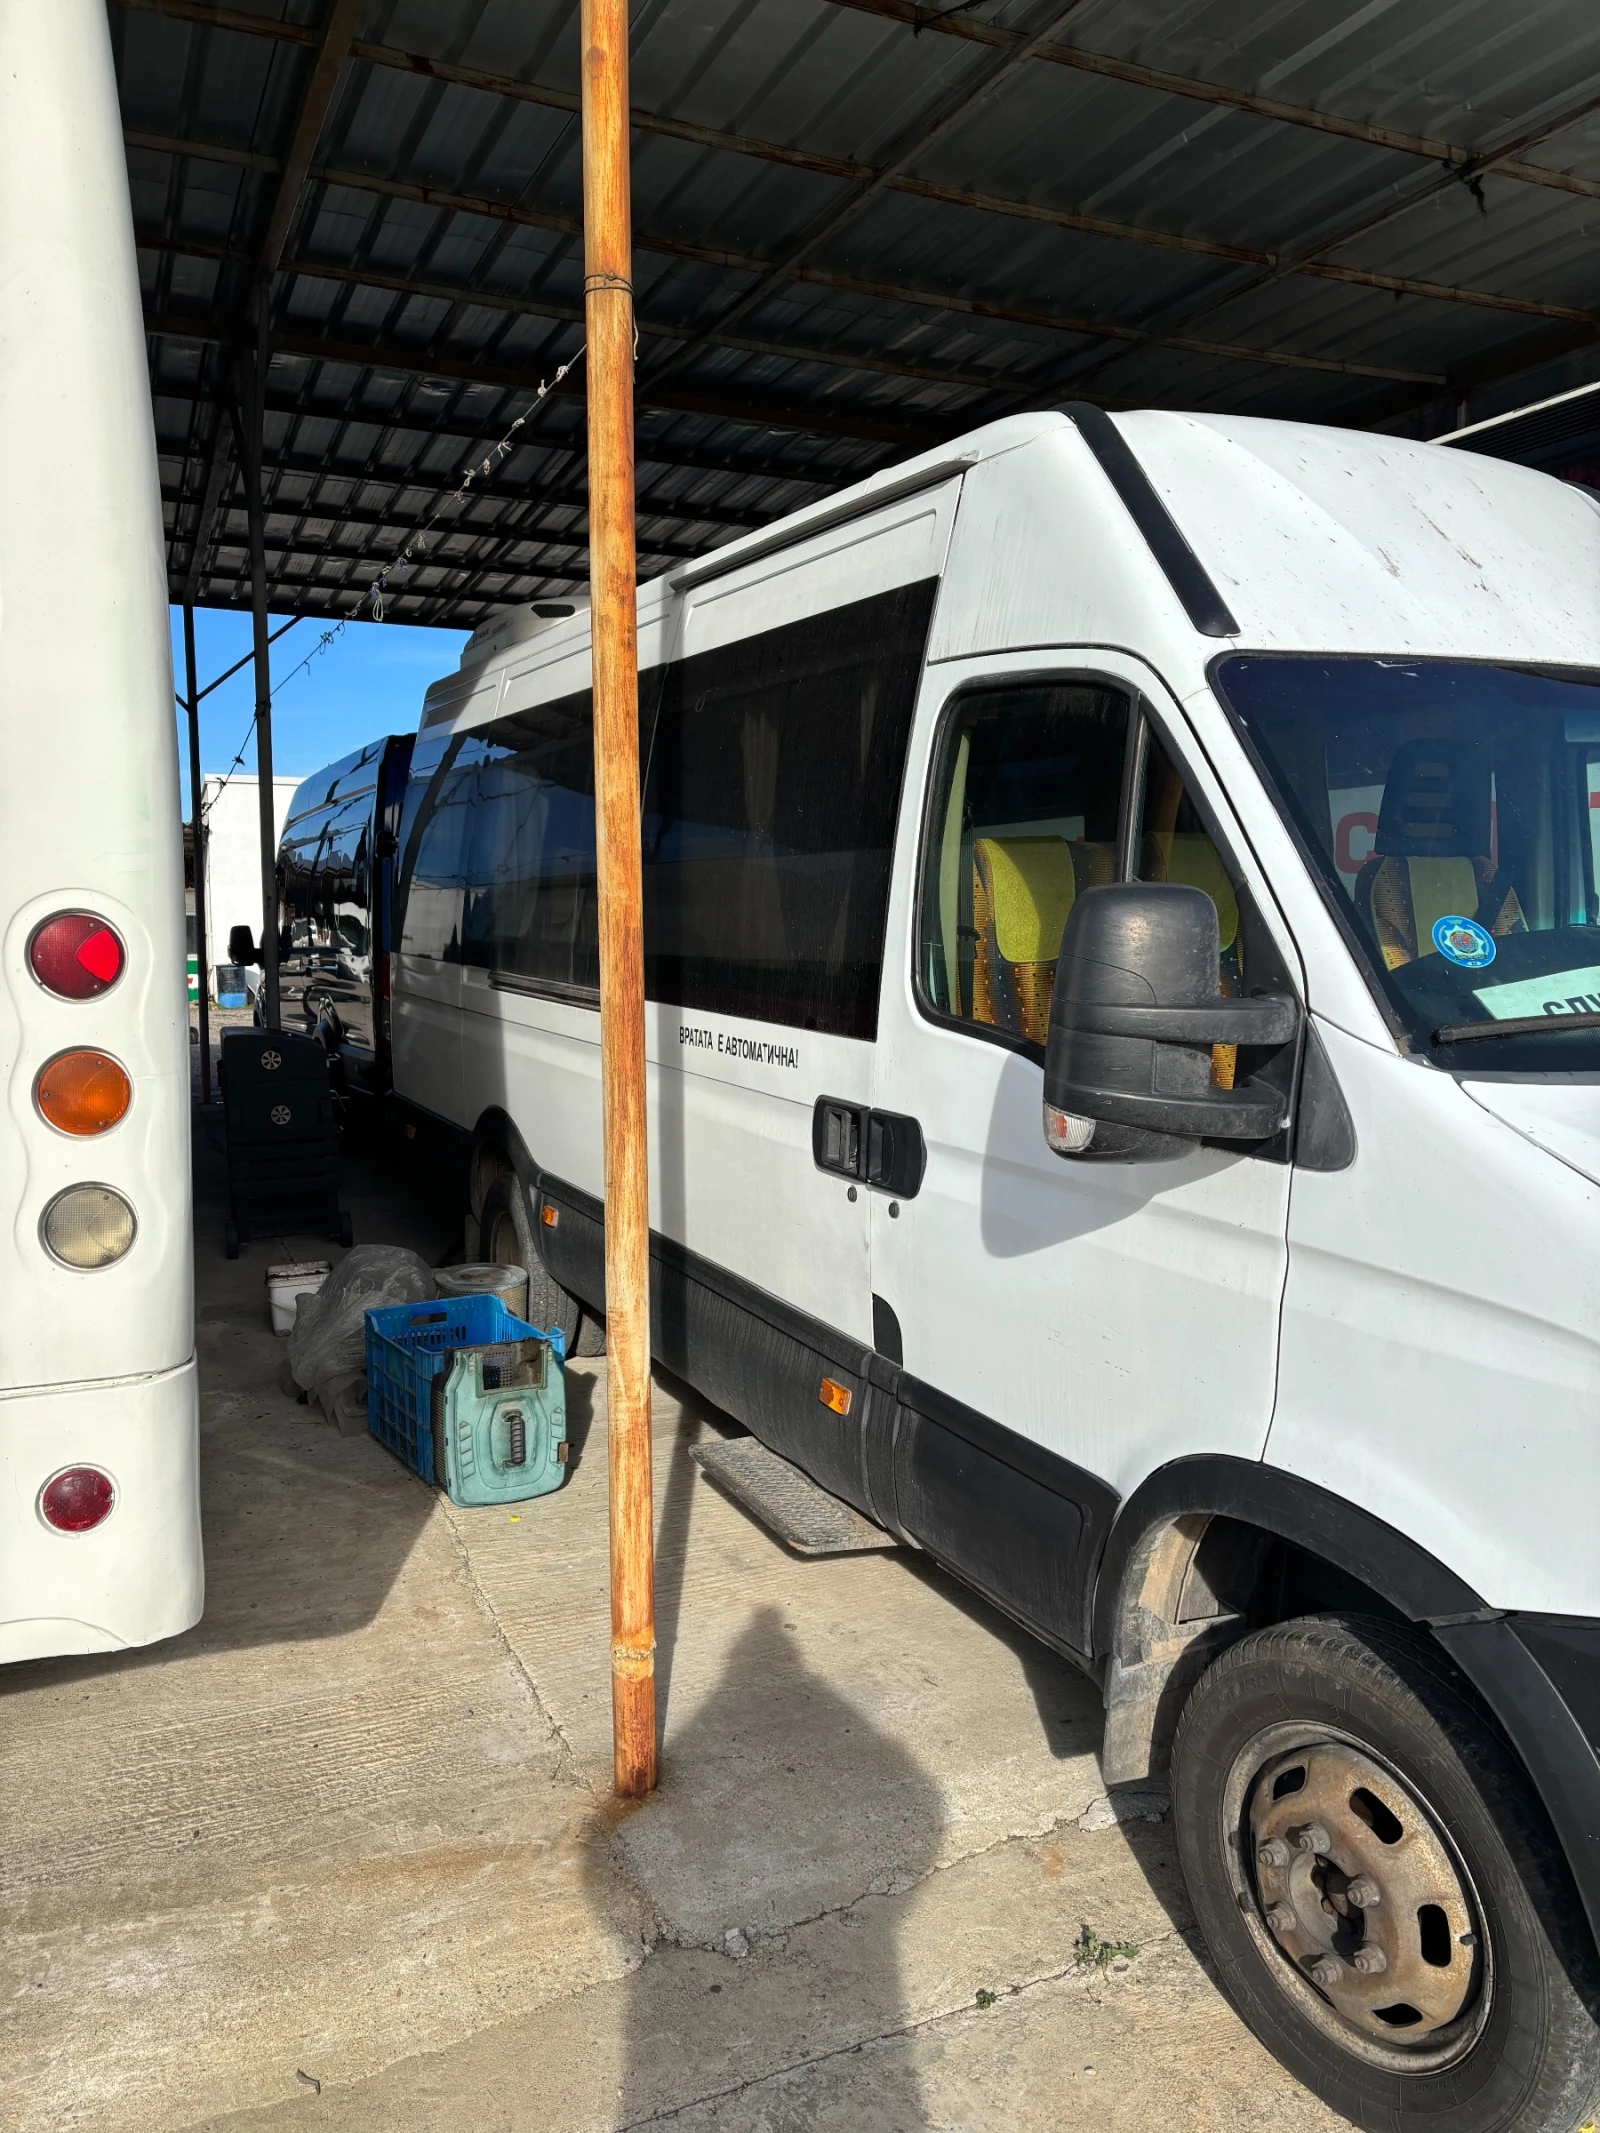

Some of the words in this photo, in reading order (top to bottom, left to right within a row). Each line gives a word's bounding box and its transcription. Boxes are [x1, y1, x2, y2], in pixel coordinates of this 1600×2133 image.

[679, 1026, 713, 1050] ВРАТАТА
[717, 1033, 724, 1053] Е
[725, 1035, 799, 1069] АВТОМАТИЧНА!
